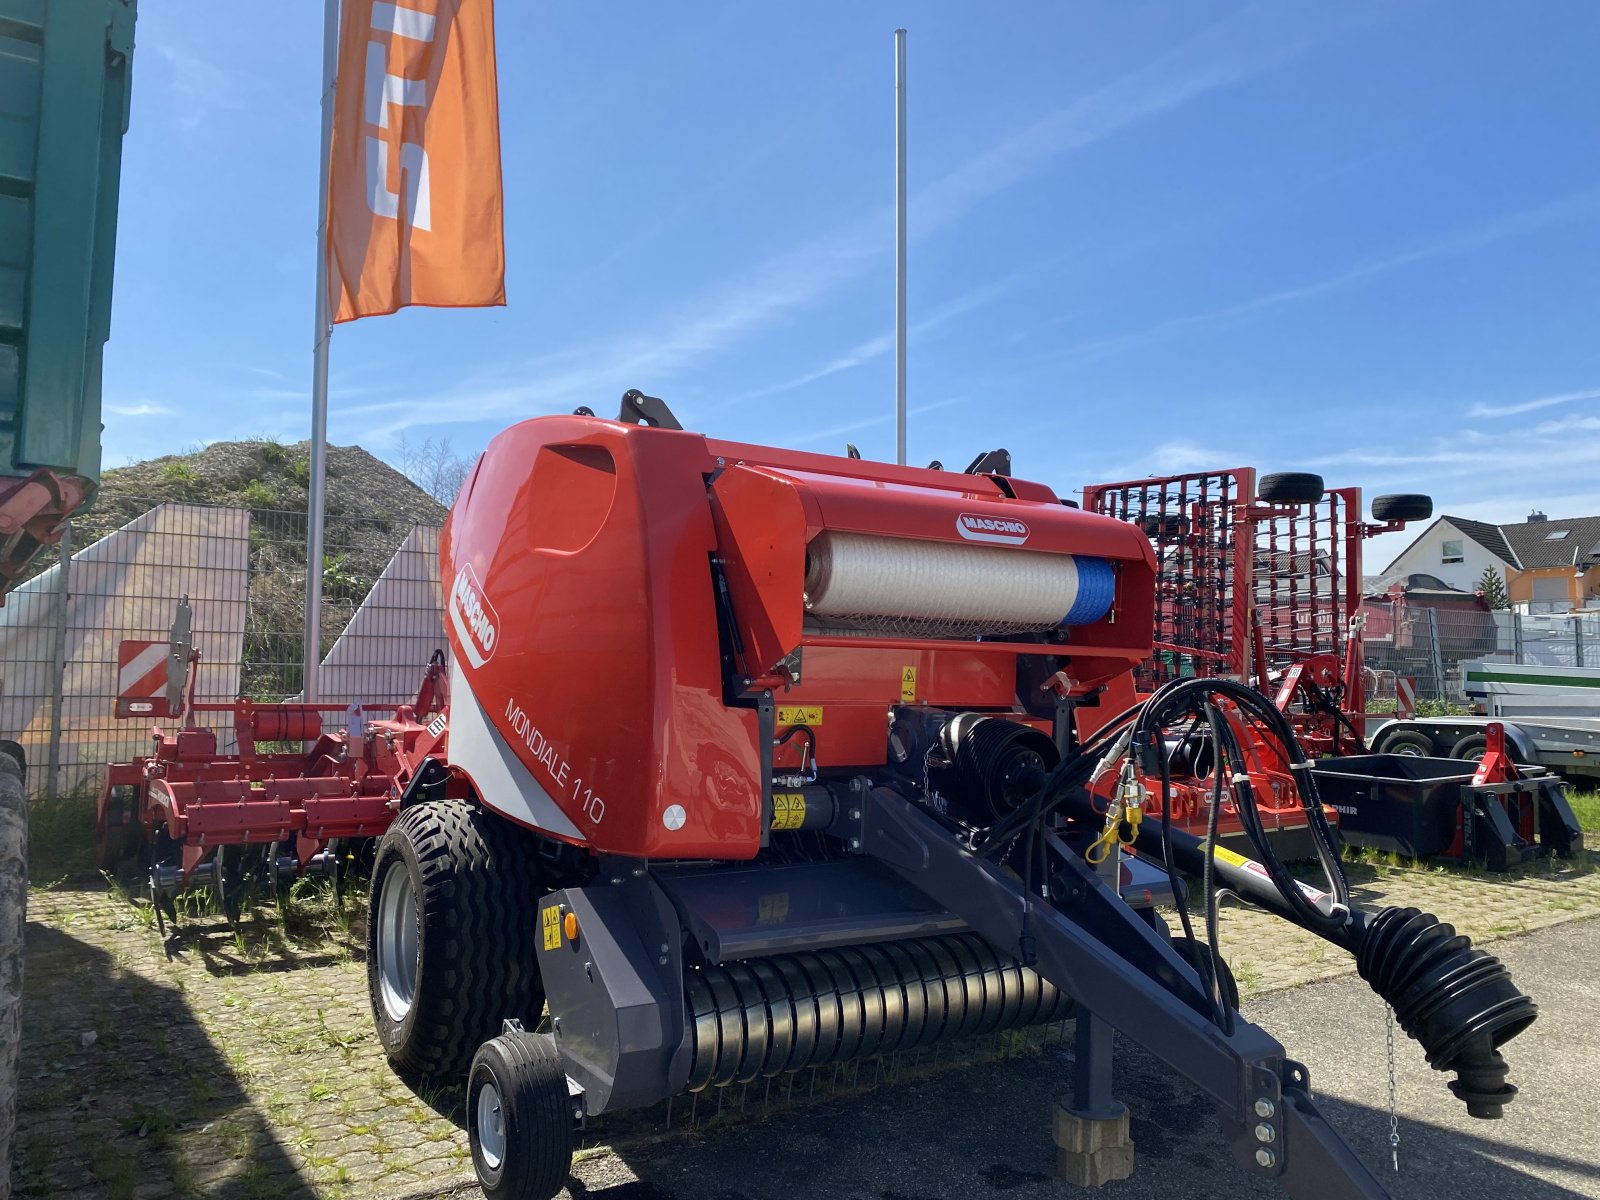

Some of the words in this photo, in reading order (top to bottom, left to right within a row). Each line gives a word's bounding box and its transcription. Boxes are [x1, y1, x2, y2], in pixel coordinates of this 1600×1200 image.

[963, 516, 1026, 533] MASCHIO
[457, 572, 495, 651] MASCHIO
[505, 697, 570, 788] MONDIALE
[573, 778, 605, 824] 110
